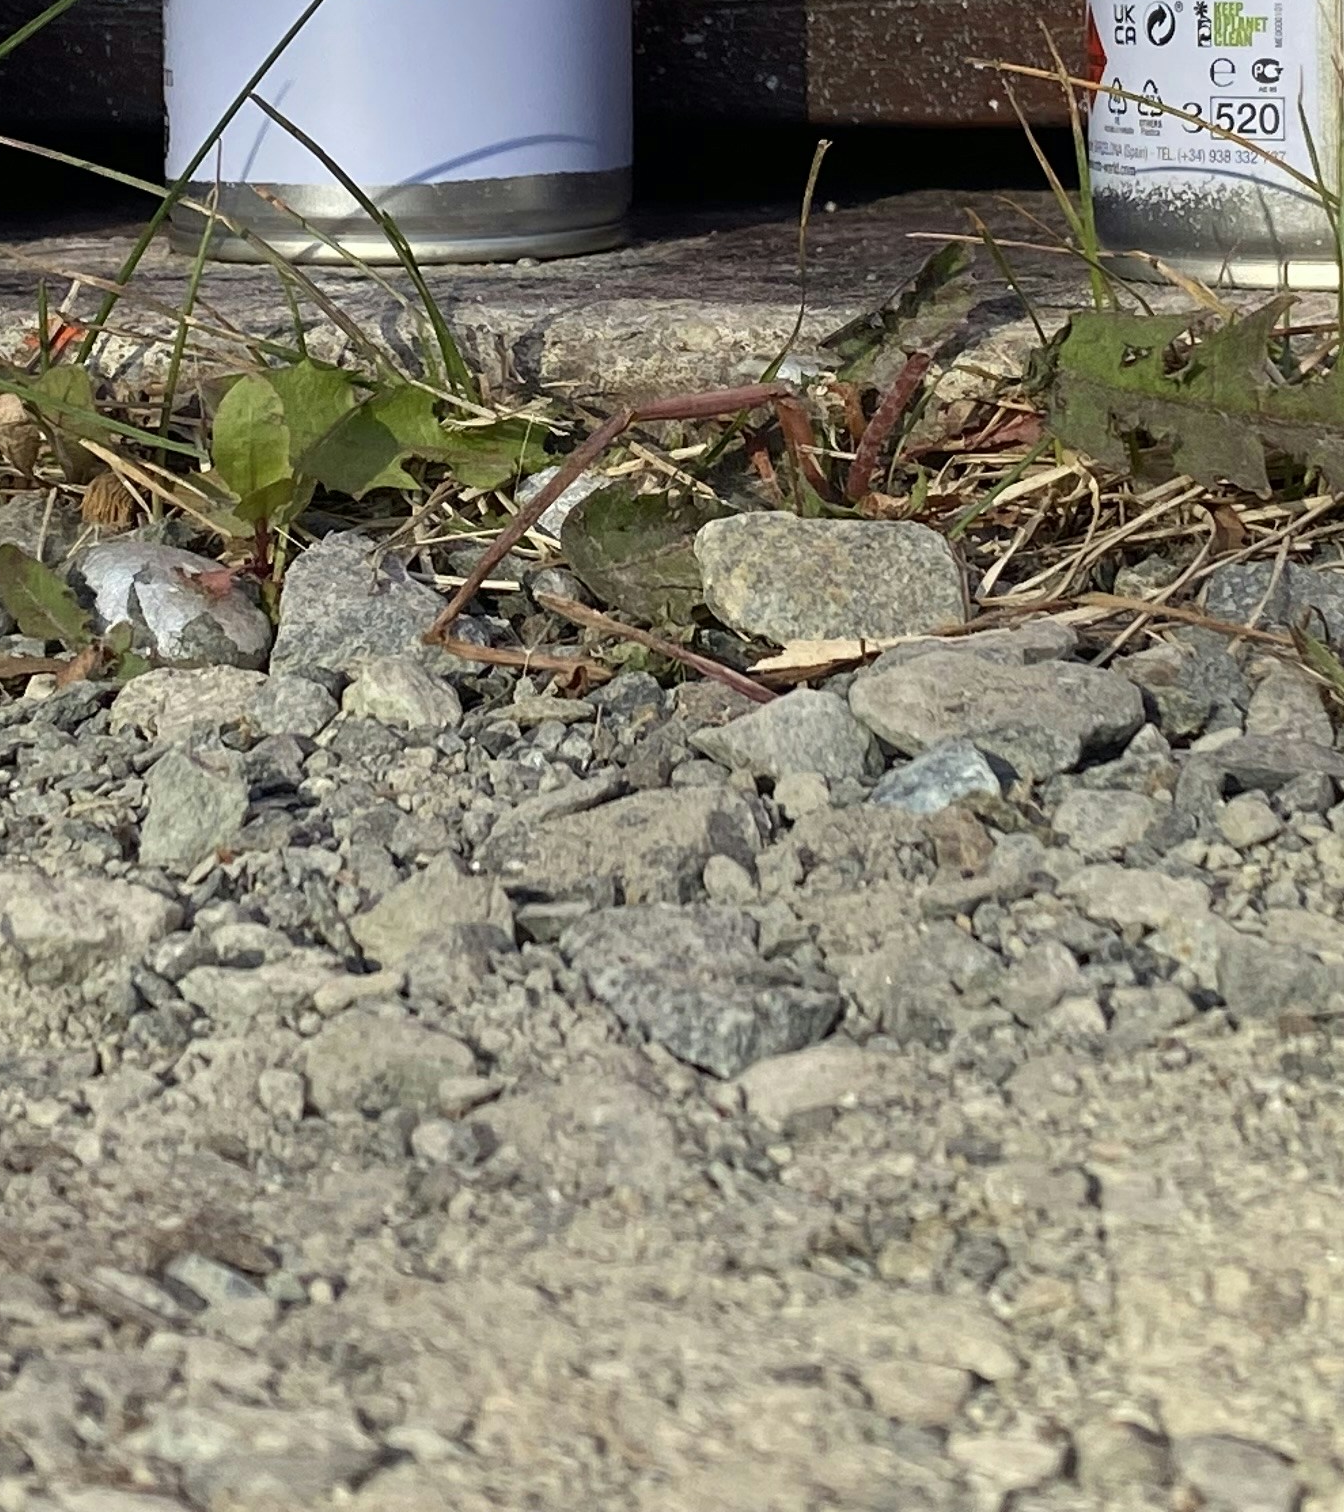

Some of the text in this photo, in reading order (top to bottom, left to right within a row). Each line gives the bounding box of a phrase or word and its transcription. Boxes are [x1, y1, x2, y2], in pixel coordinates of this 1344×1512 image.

[1113, 3, 1136, 25] UK
[1213, 0, 1244, 18] KEEP
[1114, 25, 1137, 46] CA
[1213, 31, 1254, 48] CLEAN
[1181, 101, 1281, 135] 3 520
[1123, 145, 1148, 160] (Spain)
[1177, 147, 1206, 164] (+34)
[1209, 148, 1232, 164] 938
[1234, 149, 1259, 165] 332
